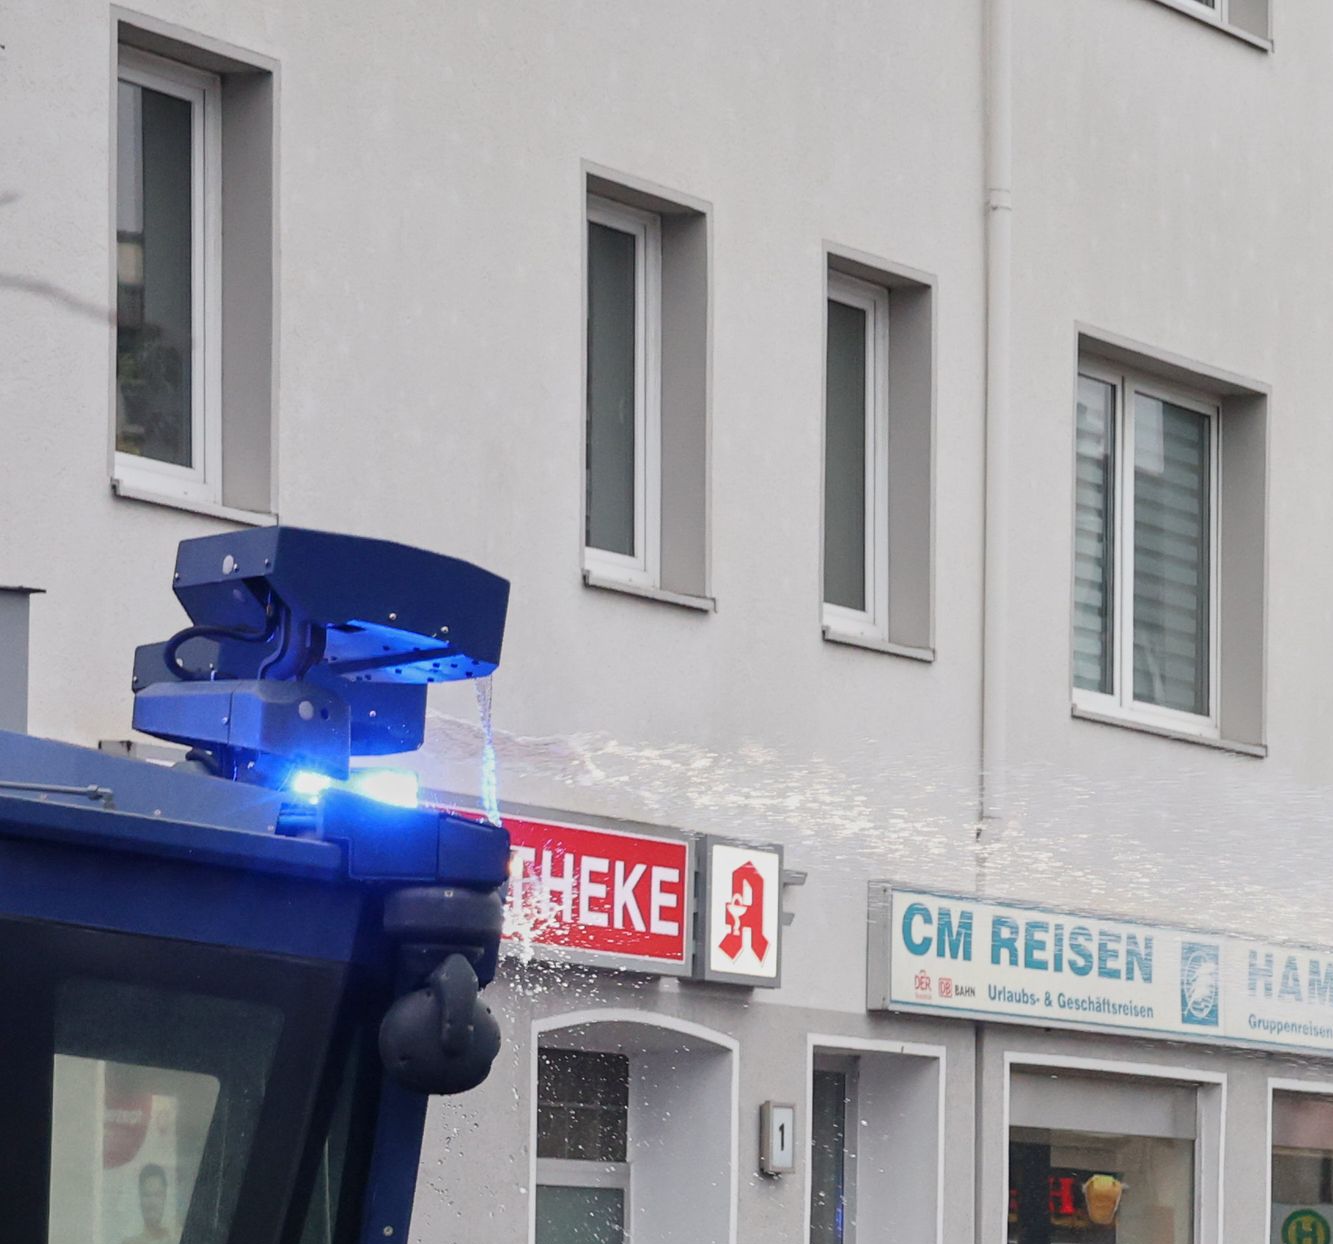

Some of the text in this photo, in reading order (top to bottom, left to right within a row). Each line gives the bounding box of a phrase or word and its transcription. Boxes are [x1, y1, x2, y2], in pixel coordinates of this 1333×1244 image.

[901, 901, 1154, 984] CM REISEN
[939, 980, 976, 997] DB BAHN
[987, 983, 1155, 1019] Urlaubs- & Geschäftsreisen
[1248, 1013, 1333, 1040] Gruppenreisen
[778, 1123, 786, 1150] 1
